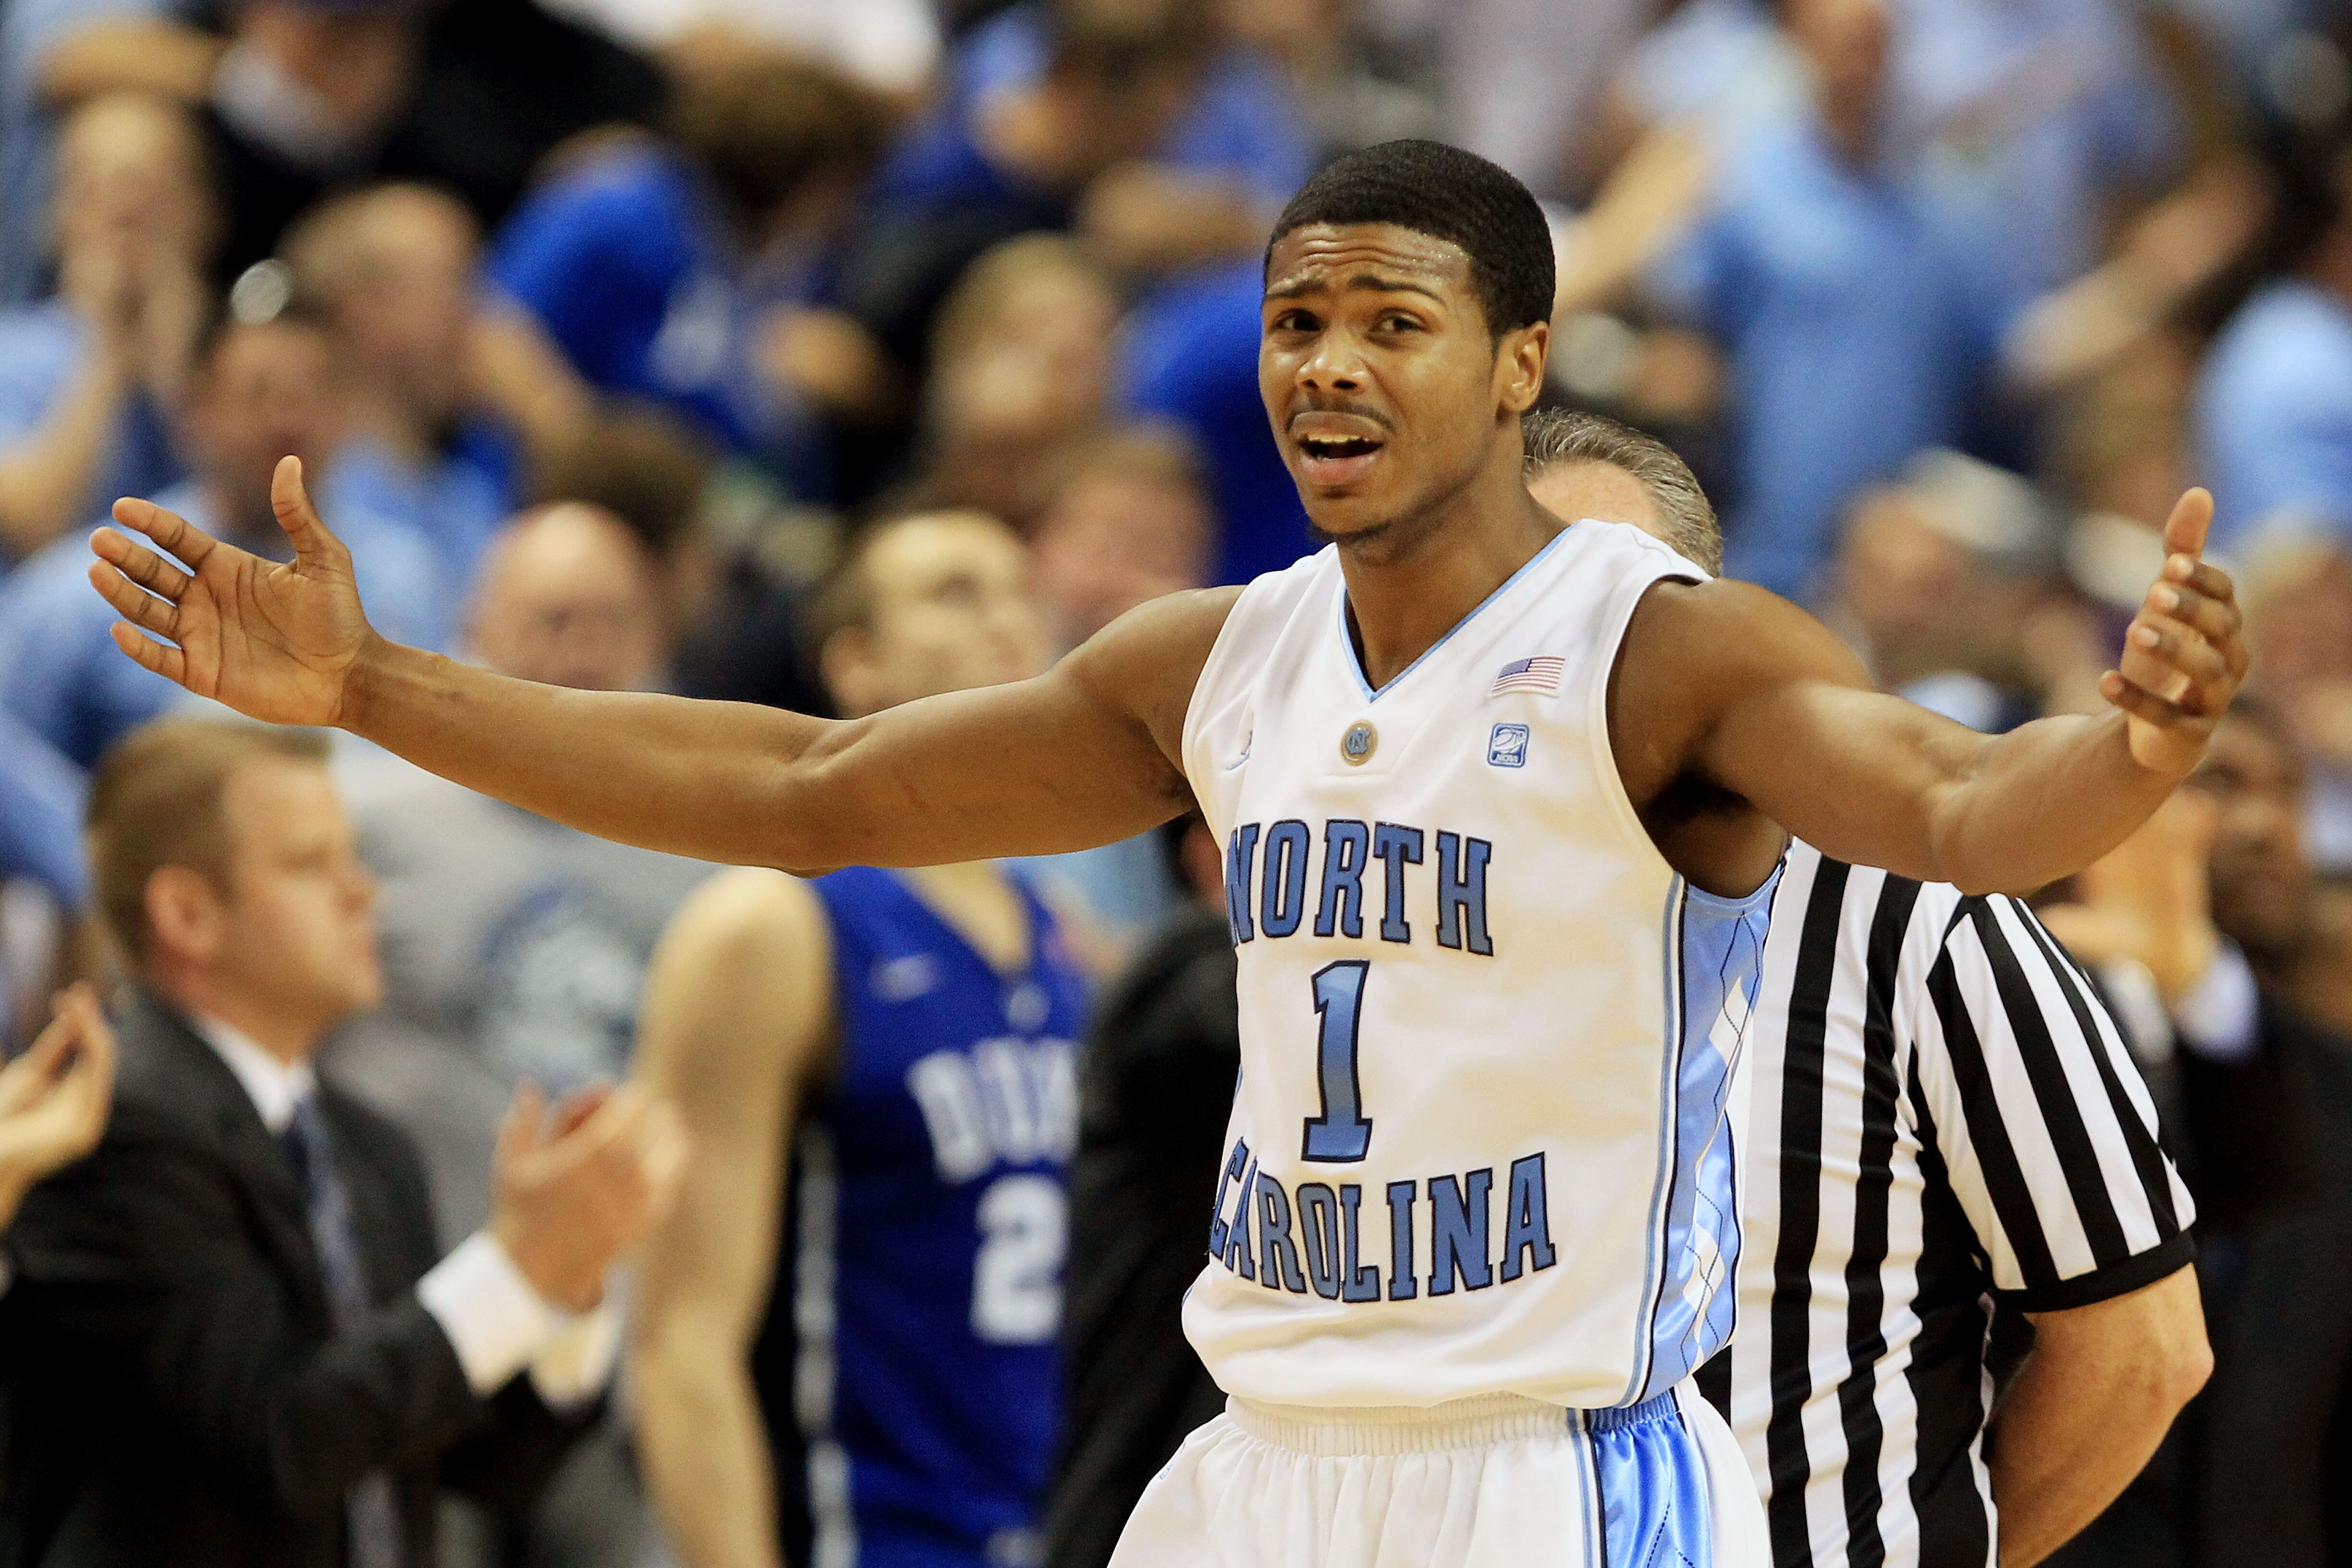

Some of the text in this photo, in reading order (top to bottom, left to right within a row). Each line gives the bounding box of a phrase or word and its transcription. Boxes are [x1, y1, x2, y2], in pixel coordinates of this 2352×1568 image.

[1225, 819, 1494, 956] NORTH
[1301, 959, 1373, 1163] 1
[1209, 1136, 1556, 1303] CAROLINA
